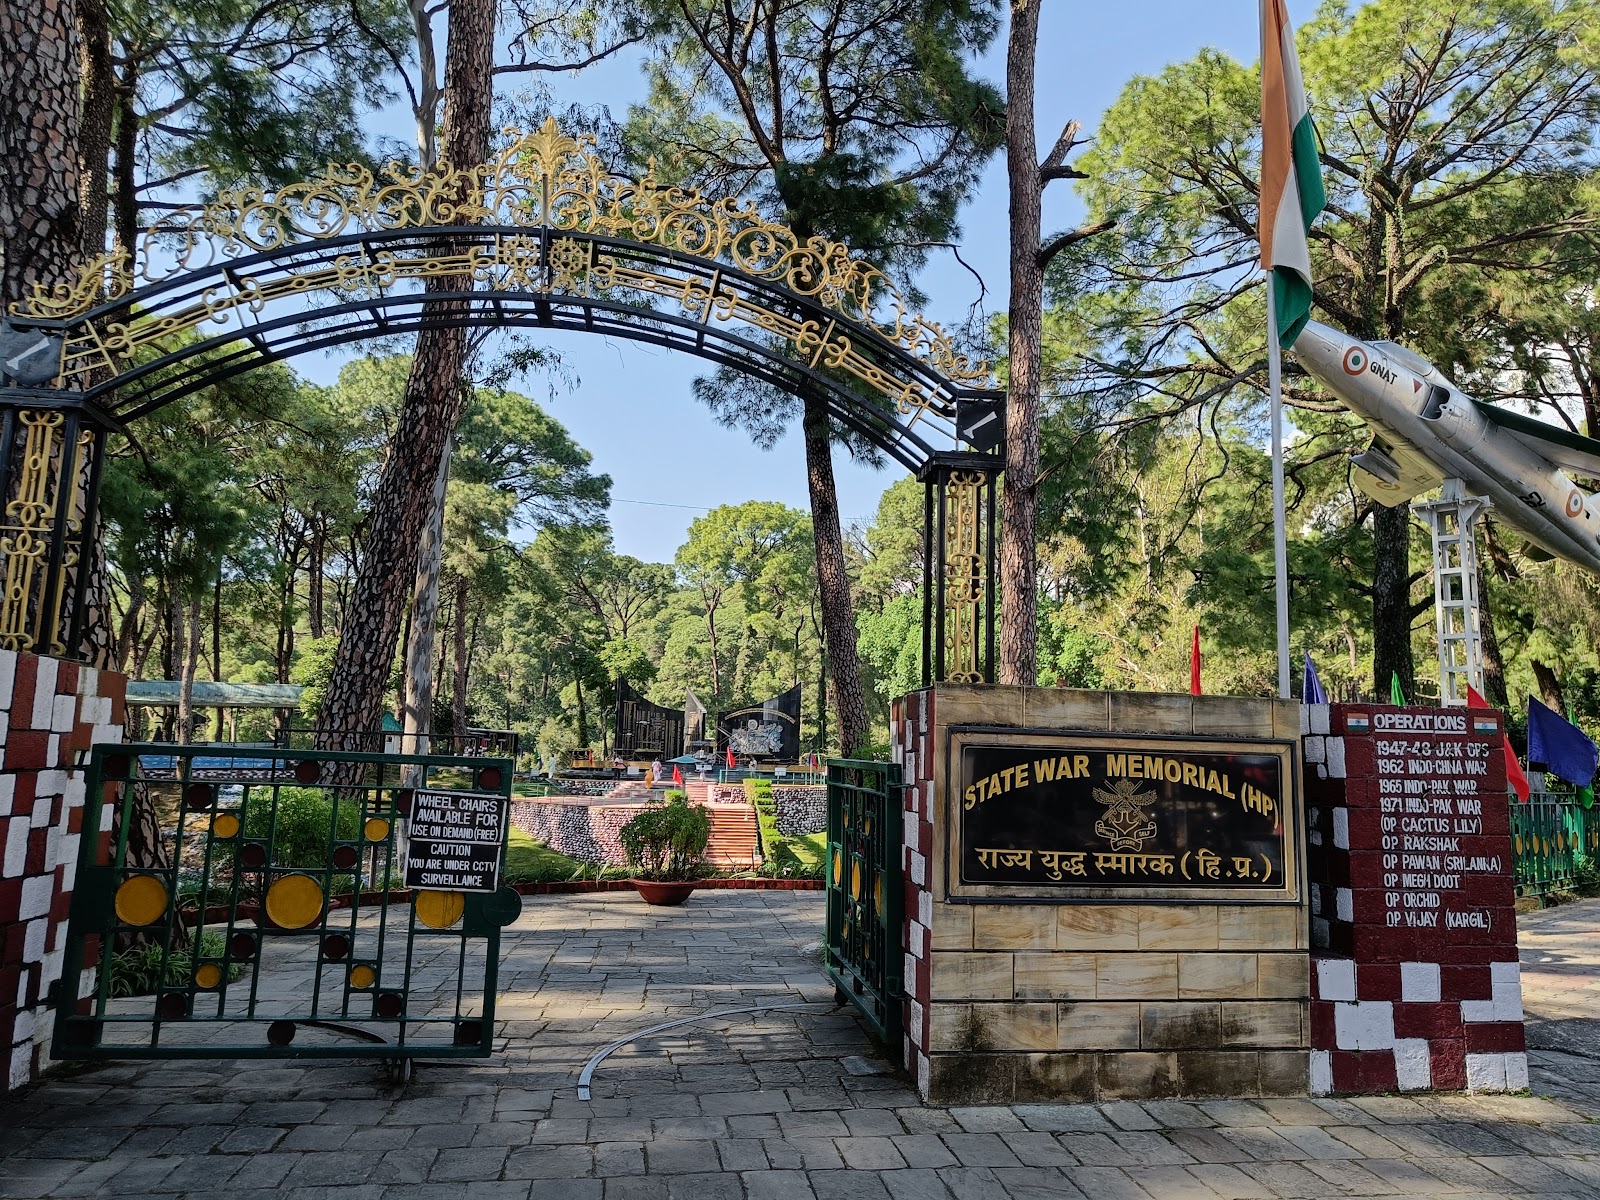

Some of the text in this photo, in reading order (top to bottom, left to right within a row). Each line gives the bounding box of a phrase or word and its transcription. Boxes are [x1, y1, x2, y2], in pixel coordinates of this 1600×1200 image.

[1370, 361, 1398, 385] GNAT
[1374, 714, 1466, 730] OPERATIONS
[1376, 741, 1431, 756] 1947-48
[1436, 742, 1463, 757] J&K
[1377, 759, 1487, 775] 1962 INDO-CHINA WAR
[964, 754, 1279, 829] STATE WAR MEMORIAL (HP)
[1379, 779, 1402, 793] 1965
[1453, 780, 1478, 795] WAR
[418, 794, 498, 812] WHEEL CHAIRS
[1380, 797, 1482, 815] 1971 INDO-PAK WAR
[417, 809, 499, 826] AVAILABLE FOR
[1381, 814, 1482, 835] (OP CACTUS LILY)
[412, 824, 429, 836] USE
[430, 825, 441, 837] ON
[430, 844, 471, 856] CAUTION
[1382, 835, 1459, 851] OP RAKSHAK
[409, 858, 495, 872] YOU ARE UNDER CCTV
[974, 848, 1033, 871] राज्य
[1038, 850, 1087, 880] युद्ध
[1092, 852, 1175, 875] स्मारक
[1383, 854, 1398, 869] OP
[1402, 855, 1440, 870] PAWAN
[420, 873, 482, 887] SURVEILLANCE
[1384, 873, 1460, 888] OP MEGH DOOT
[1385, 892, 1440, 908] OP ORCHID
[1386, 911, 1401, 927] OP
[1445, 908, 1491, 933] (KARGIL)
